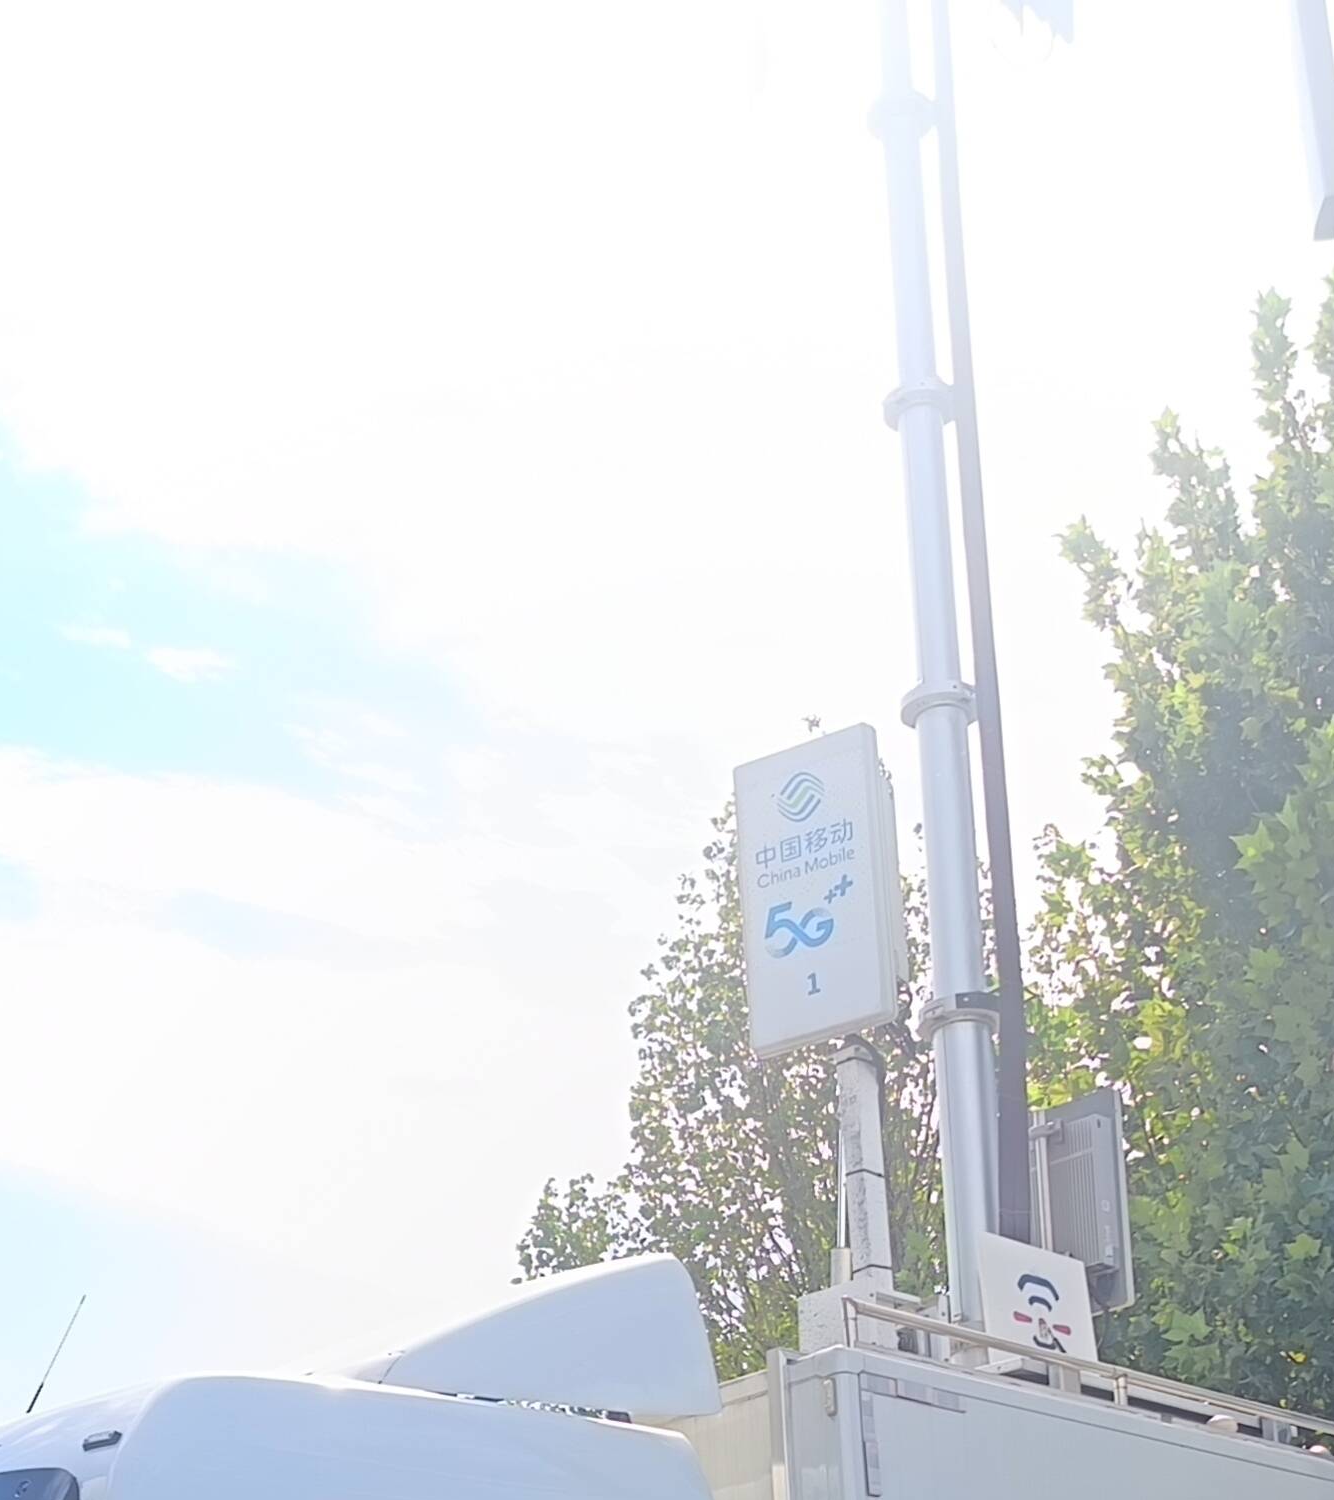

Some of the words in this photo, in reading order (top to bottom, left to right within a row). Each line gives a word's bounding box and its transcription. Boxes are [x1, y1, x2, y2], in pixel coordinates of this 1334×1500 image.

[756, 819, 853, 868] 中国移动
[757, 864, 802, 888] China
[804, 847, 855, 875] Mobile
[807, 972, 821, 996] 1
